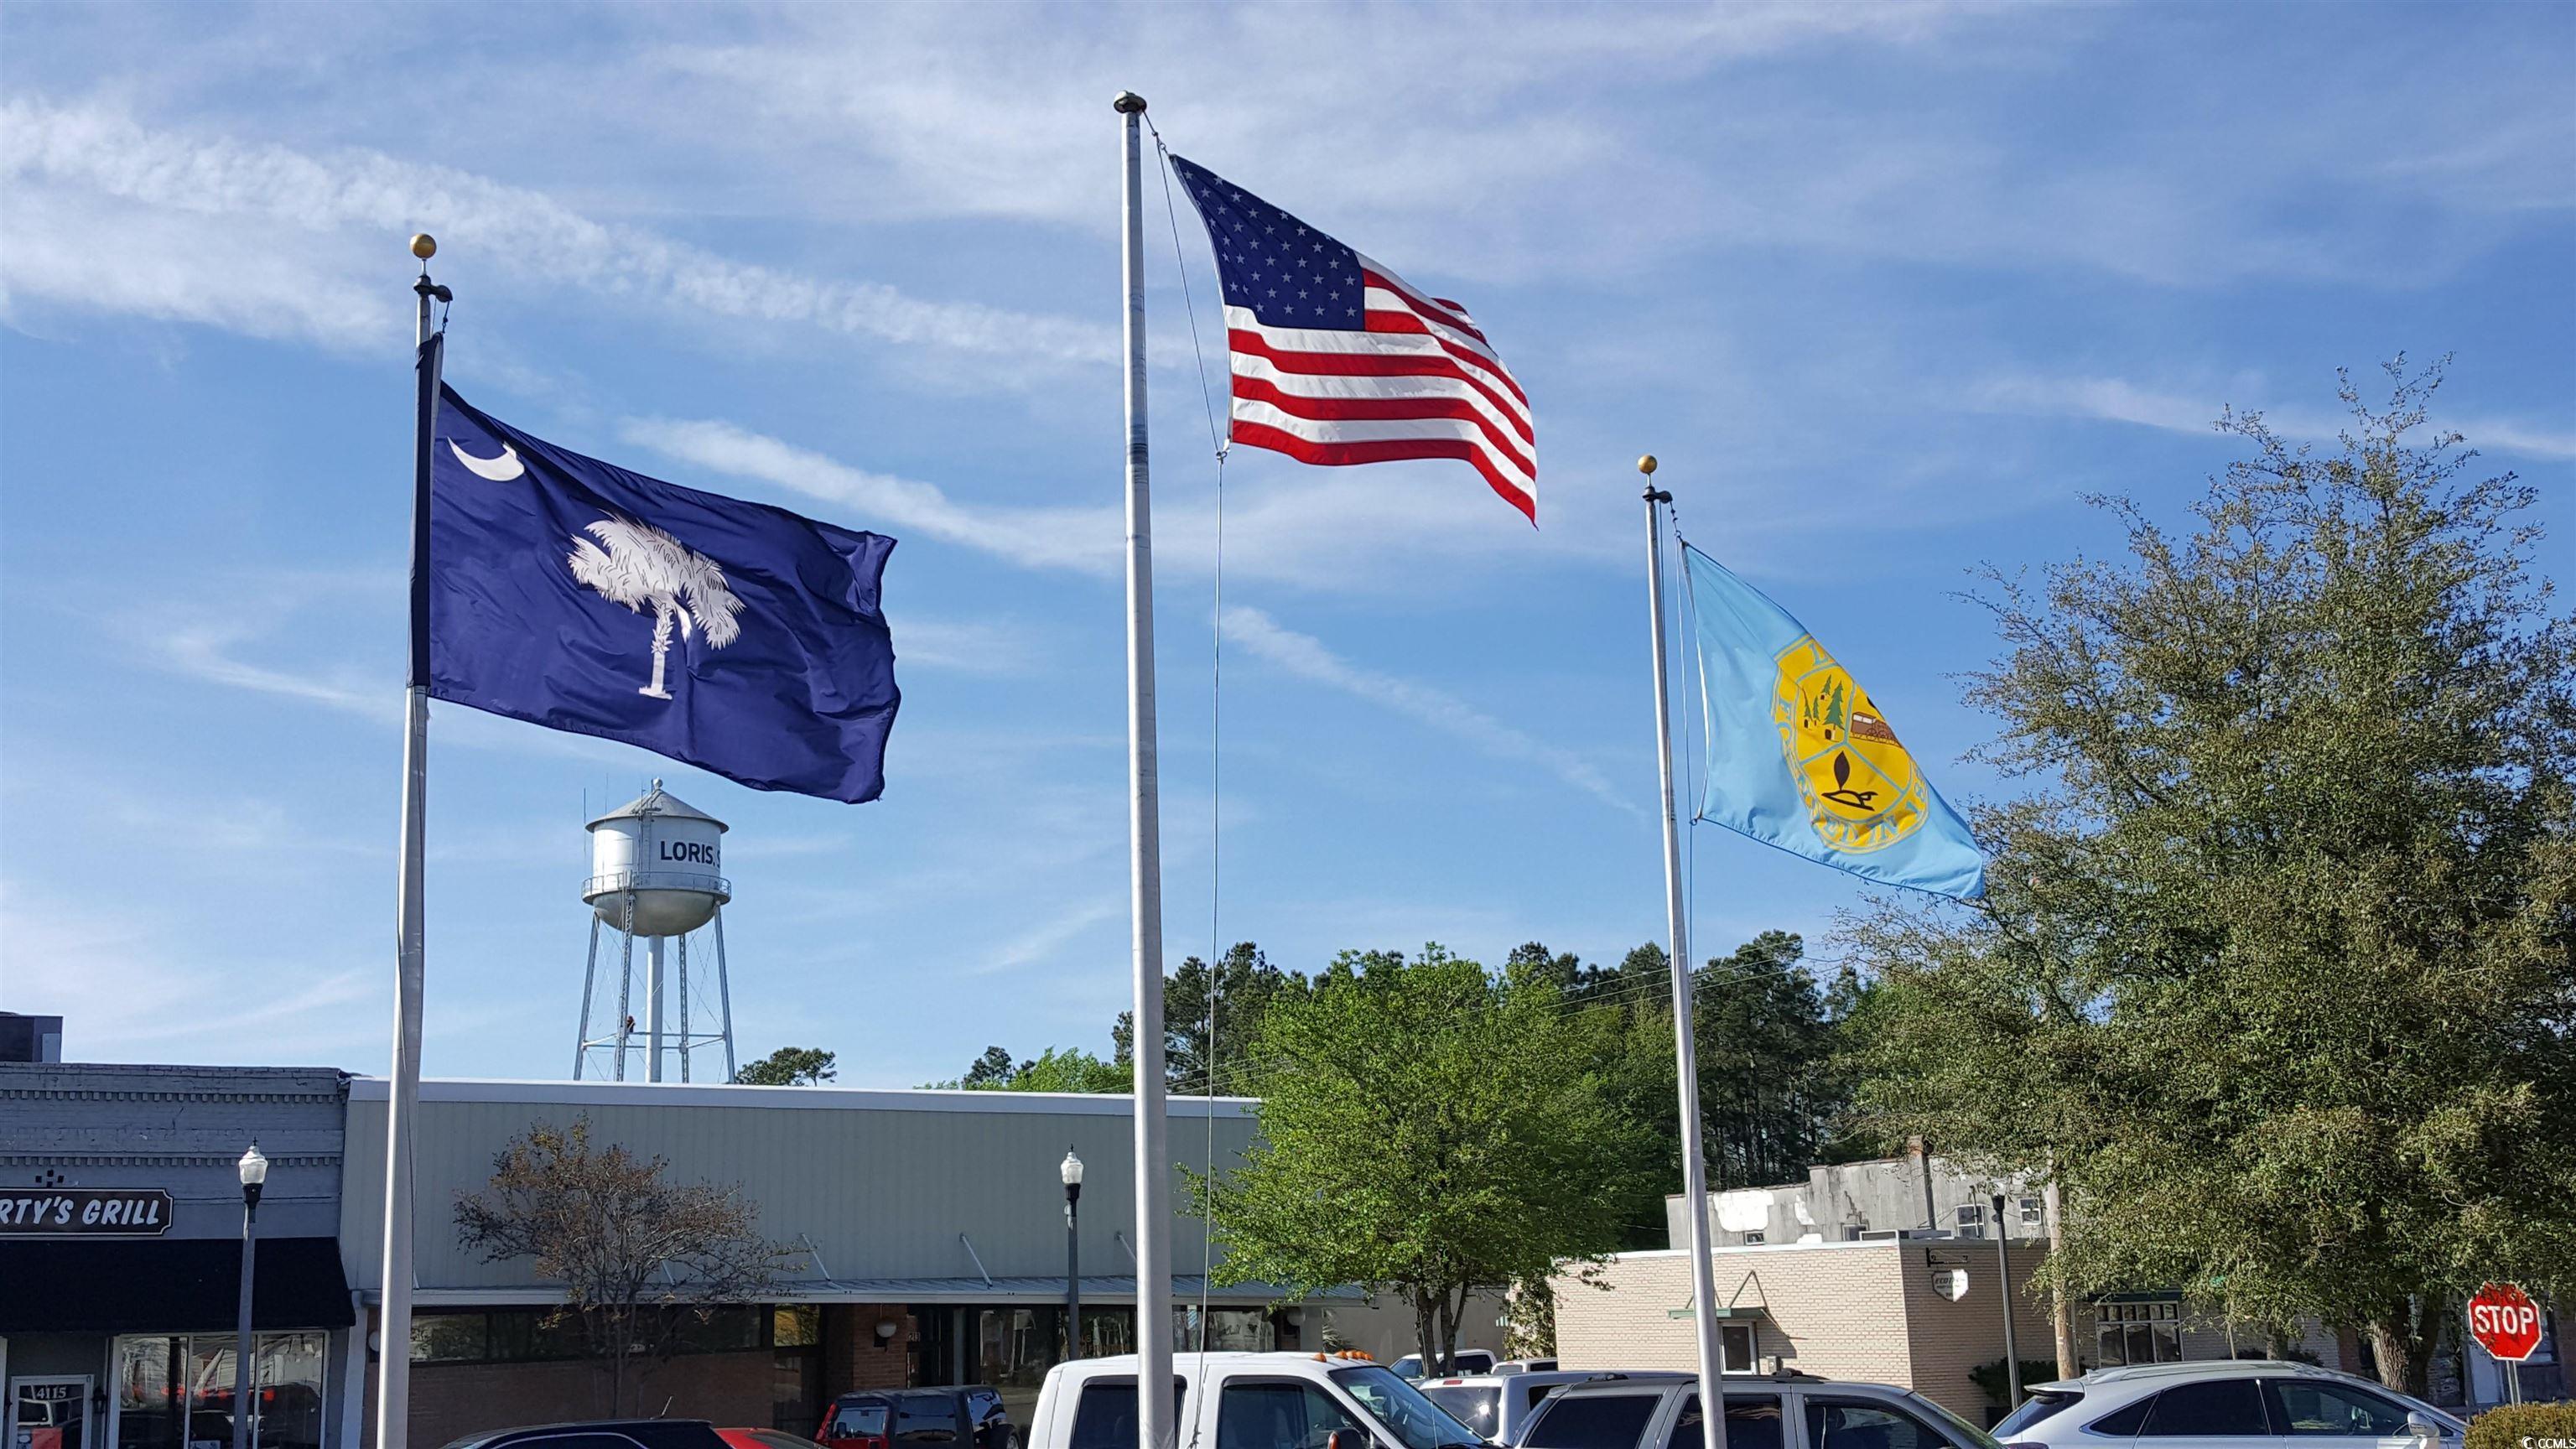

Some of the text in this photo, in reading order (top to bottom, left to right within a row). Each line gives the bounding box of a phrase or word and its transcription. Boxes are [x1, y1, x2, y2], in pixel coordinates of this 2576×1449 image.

[82, 1199, 159, 1225] GRILL
[2474, 1304, 2535, 1336] STOP
[36, 1386, 67, 1400] 4115
